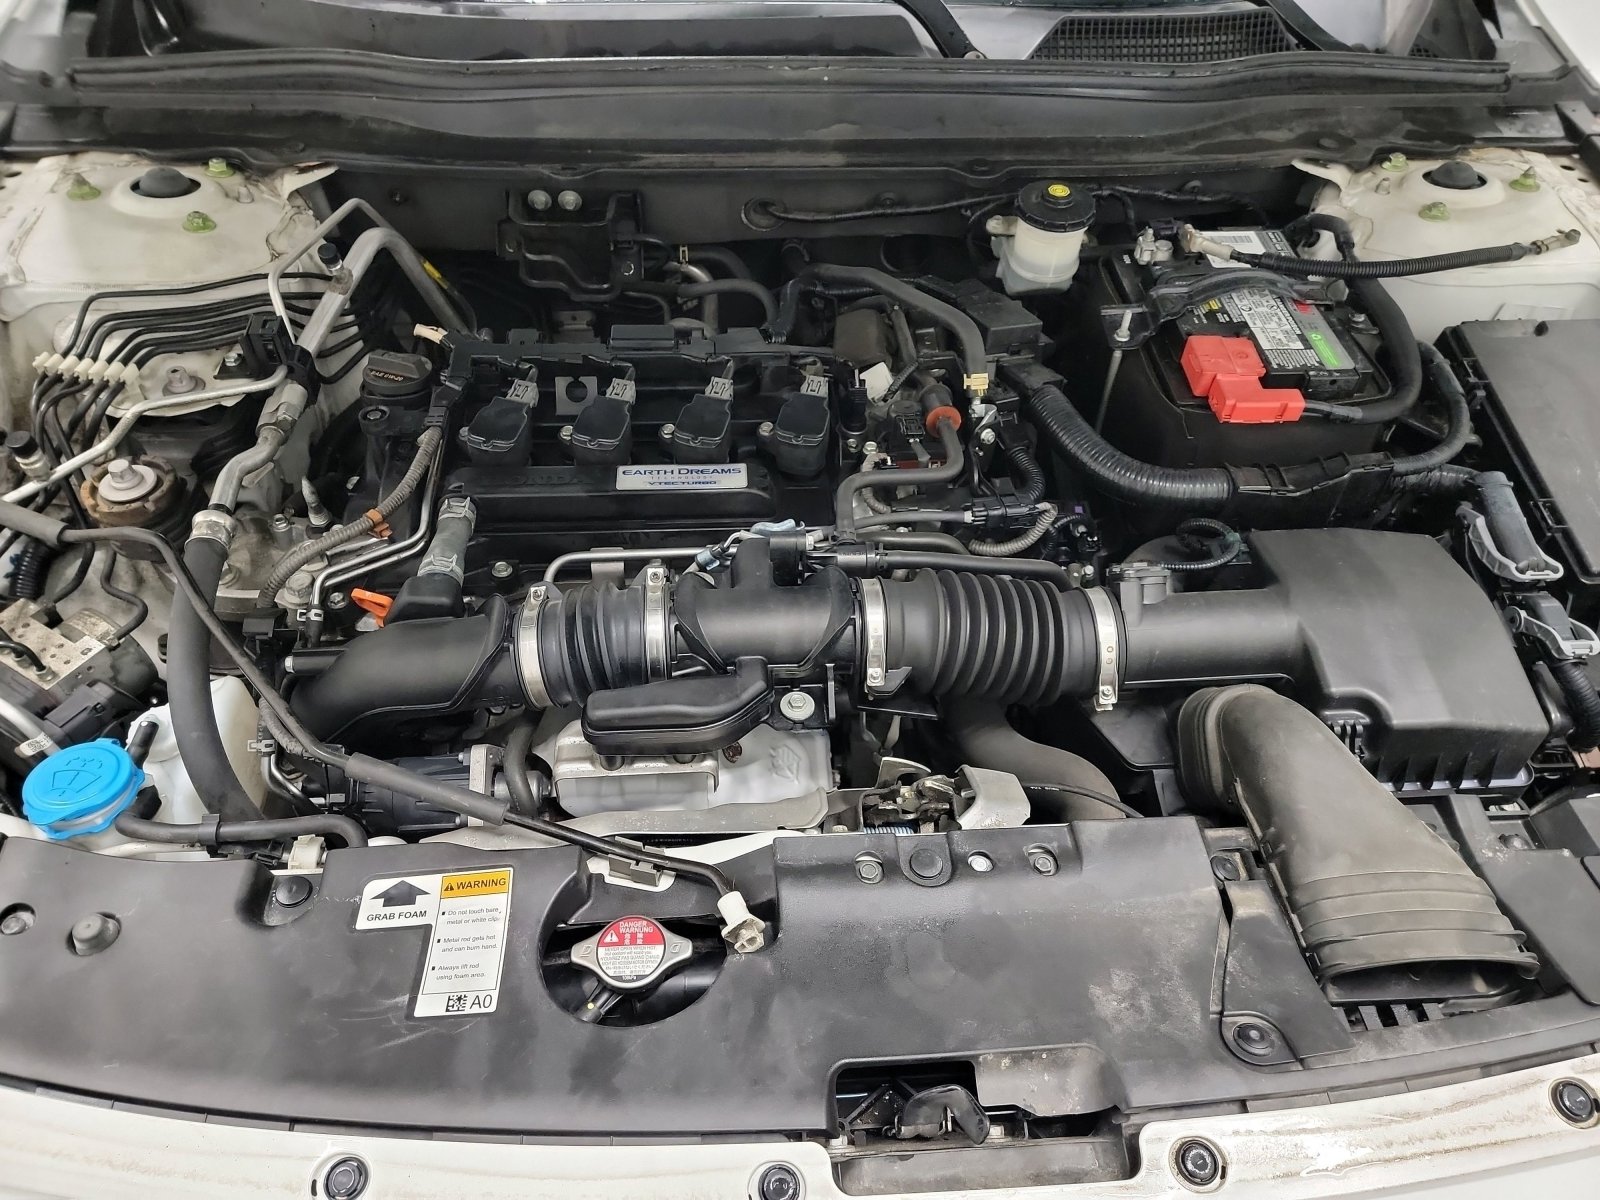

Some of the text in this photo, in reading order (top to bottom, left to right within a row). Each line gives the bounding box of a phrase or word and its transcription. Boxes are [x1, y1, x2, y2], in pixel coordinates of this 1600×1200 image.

[678, 467, 742, 475] DREAMS
[456, 877, 506, 890] WARNING
[366, 910, 427, 922] GRAB FOAM
[472, 935, 485, 943] gets
